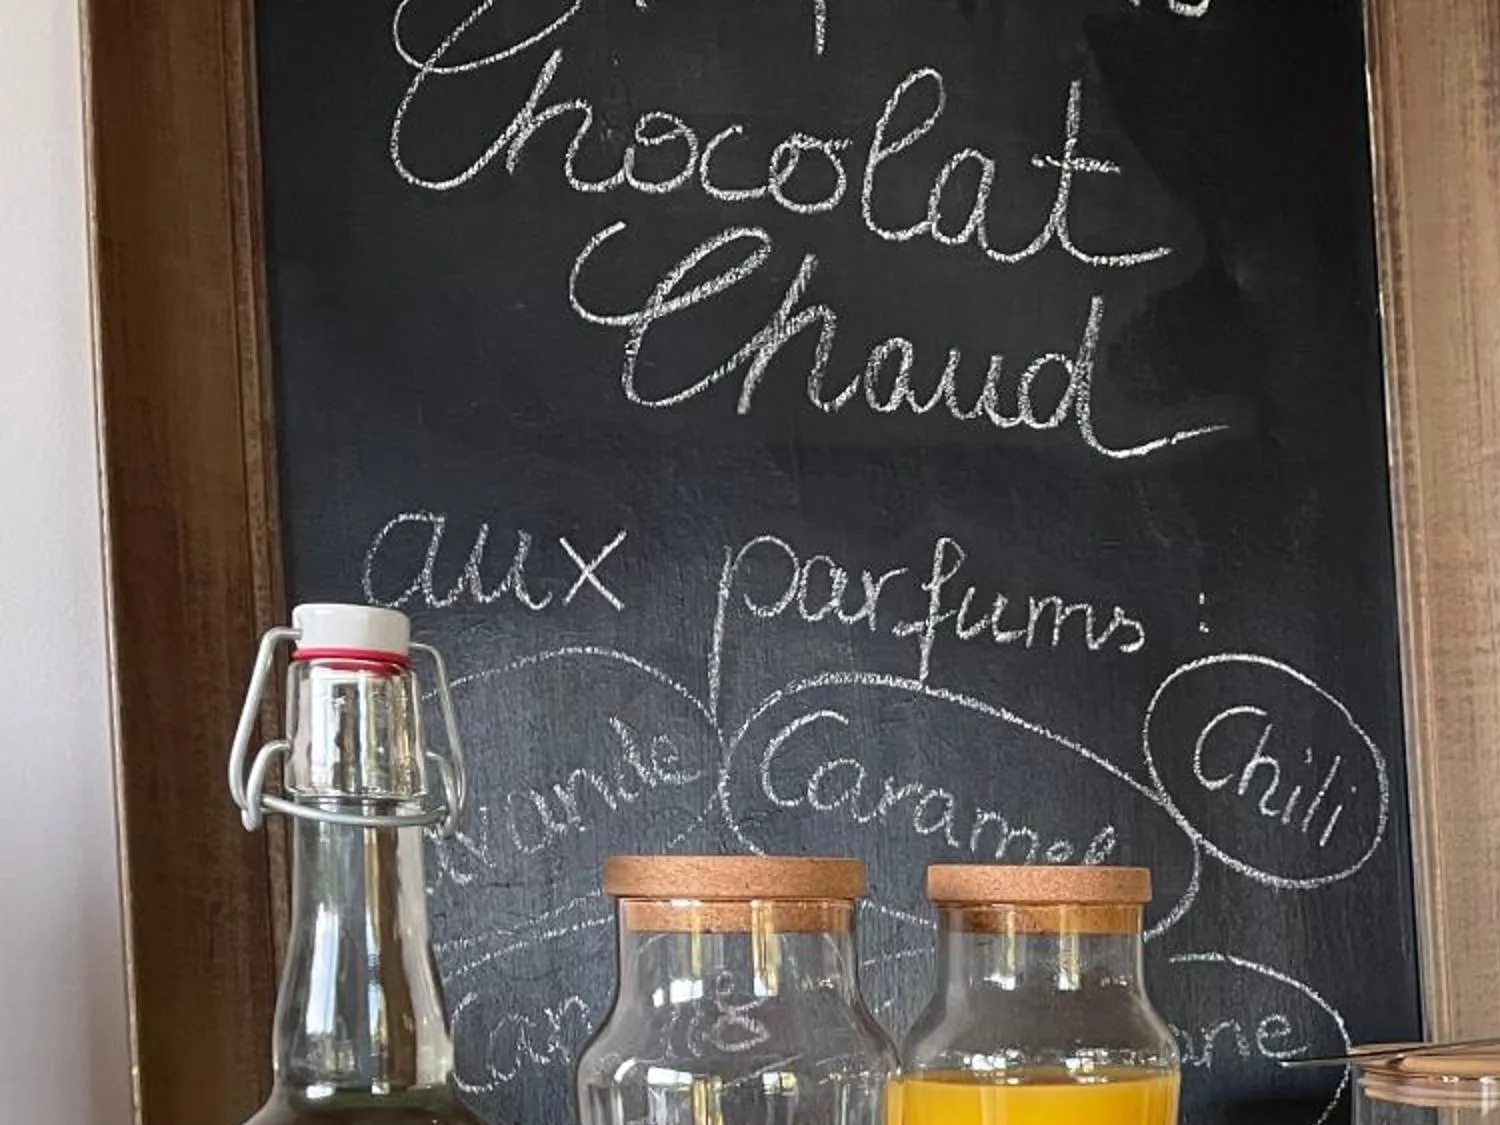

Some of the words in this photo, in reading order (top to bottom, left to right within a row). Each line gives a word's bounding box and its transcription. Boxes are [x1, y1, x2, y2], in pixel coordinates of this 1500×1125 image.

[388, 0, 1172, 266] Chocolat
[570, 221, 1230, 458] Chaud
[363, 510, 627, 611] aux
[707, 533, 1147, 724] parfums
[760, 708, 1117, 867] Caramel
[1194, 704, 1358, 848] Chili
